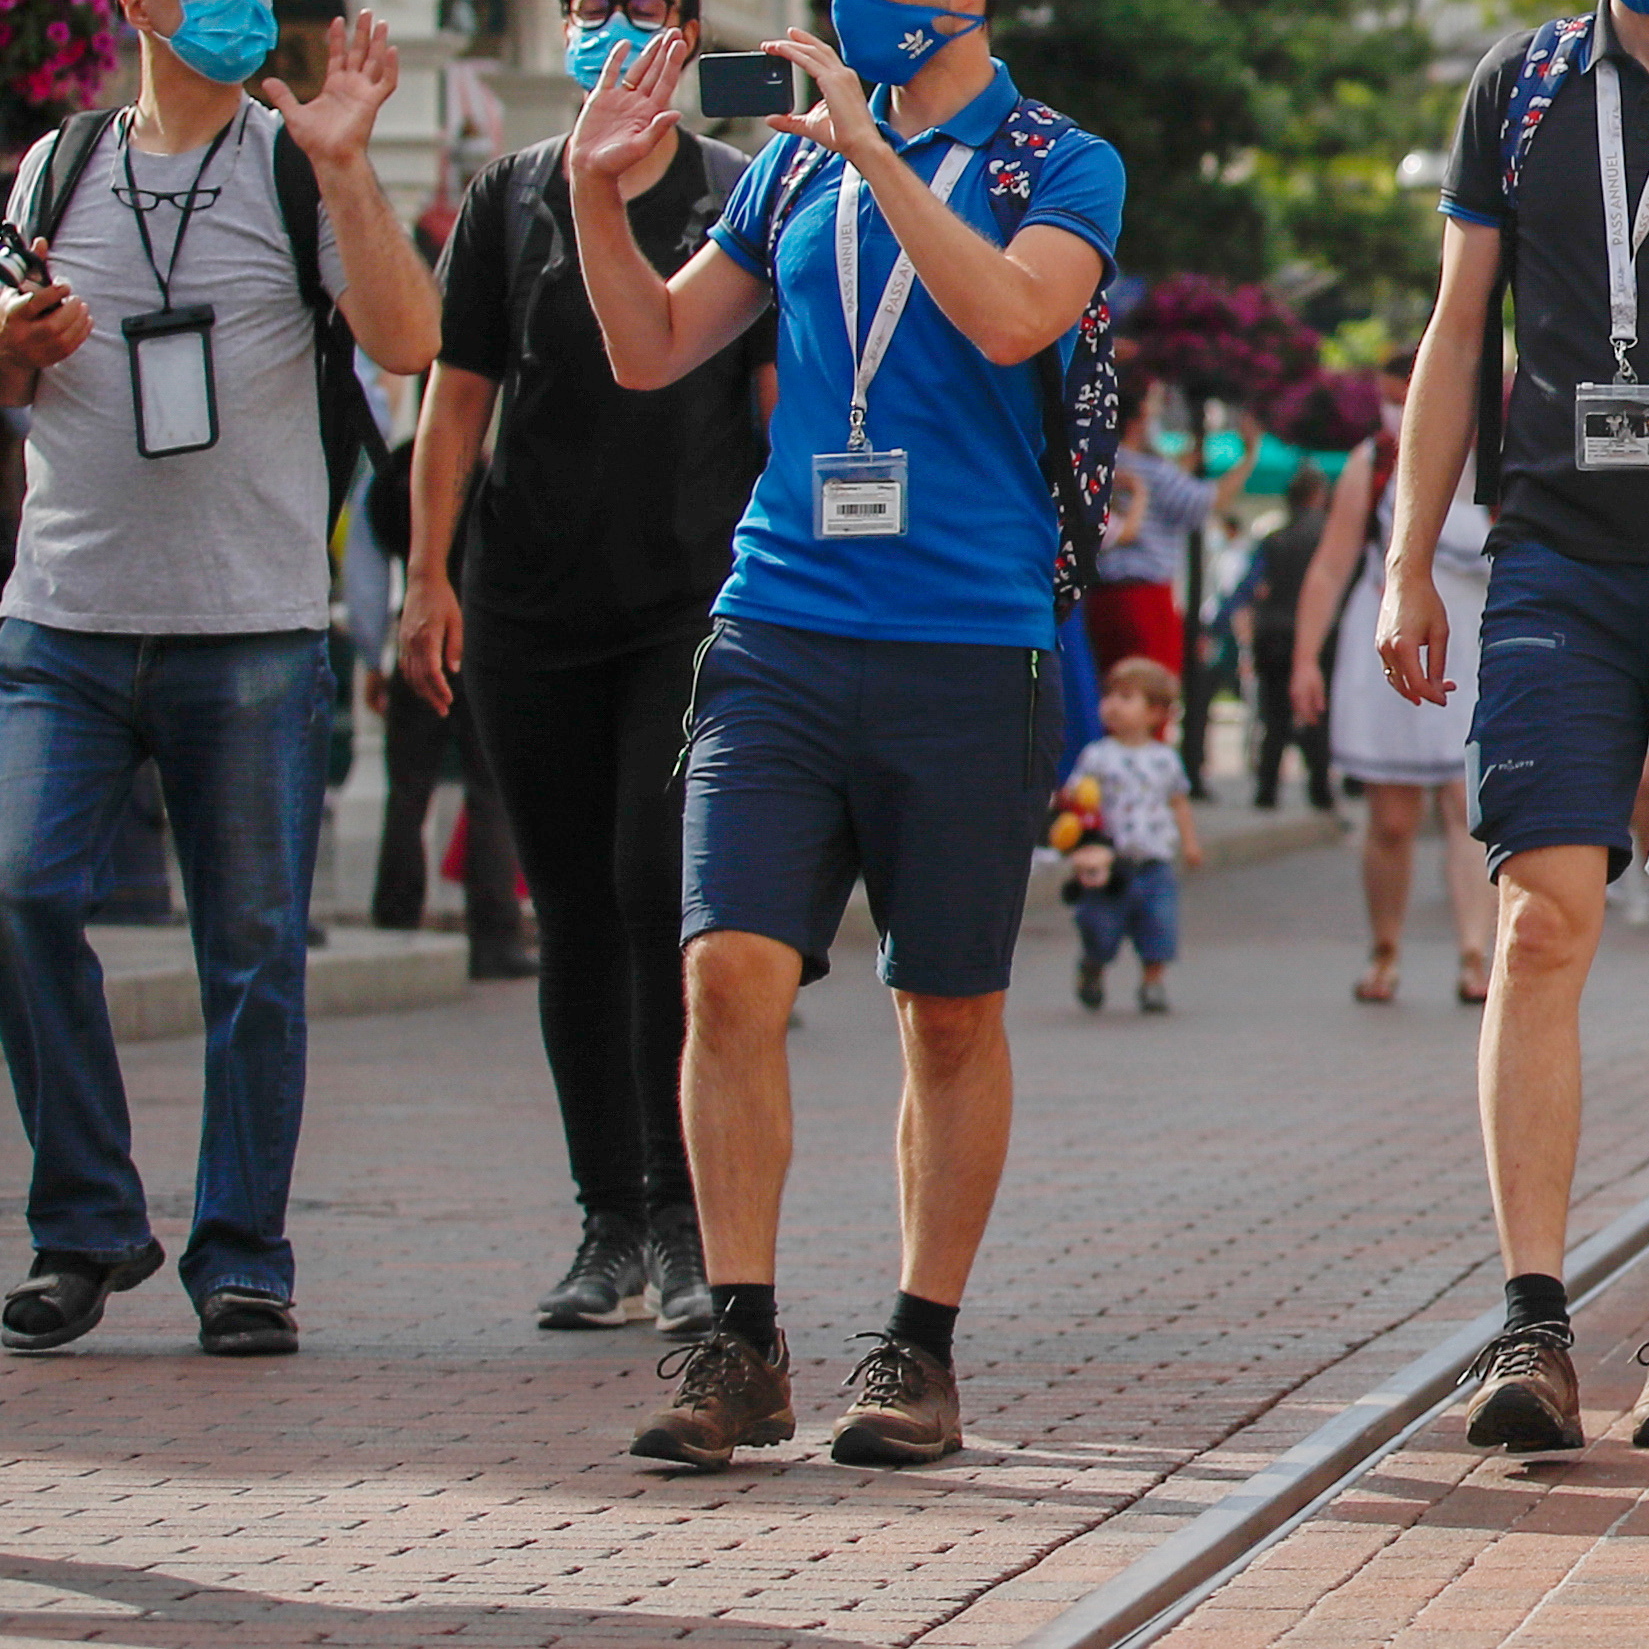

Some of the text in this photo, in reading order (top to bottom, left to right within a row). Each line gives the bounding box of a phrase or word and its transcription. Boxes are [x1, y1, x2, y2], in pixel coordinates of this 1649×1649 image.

[1606, 152, 1624, 246] PASS ANNUEL
[841, 219, 853, 276] ANNUEL
[884, 279, 906, 315] PASS
